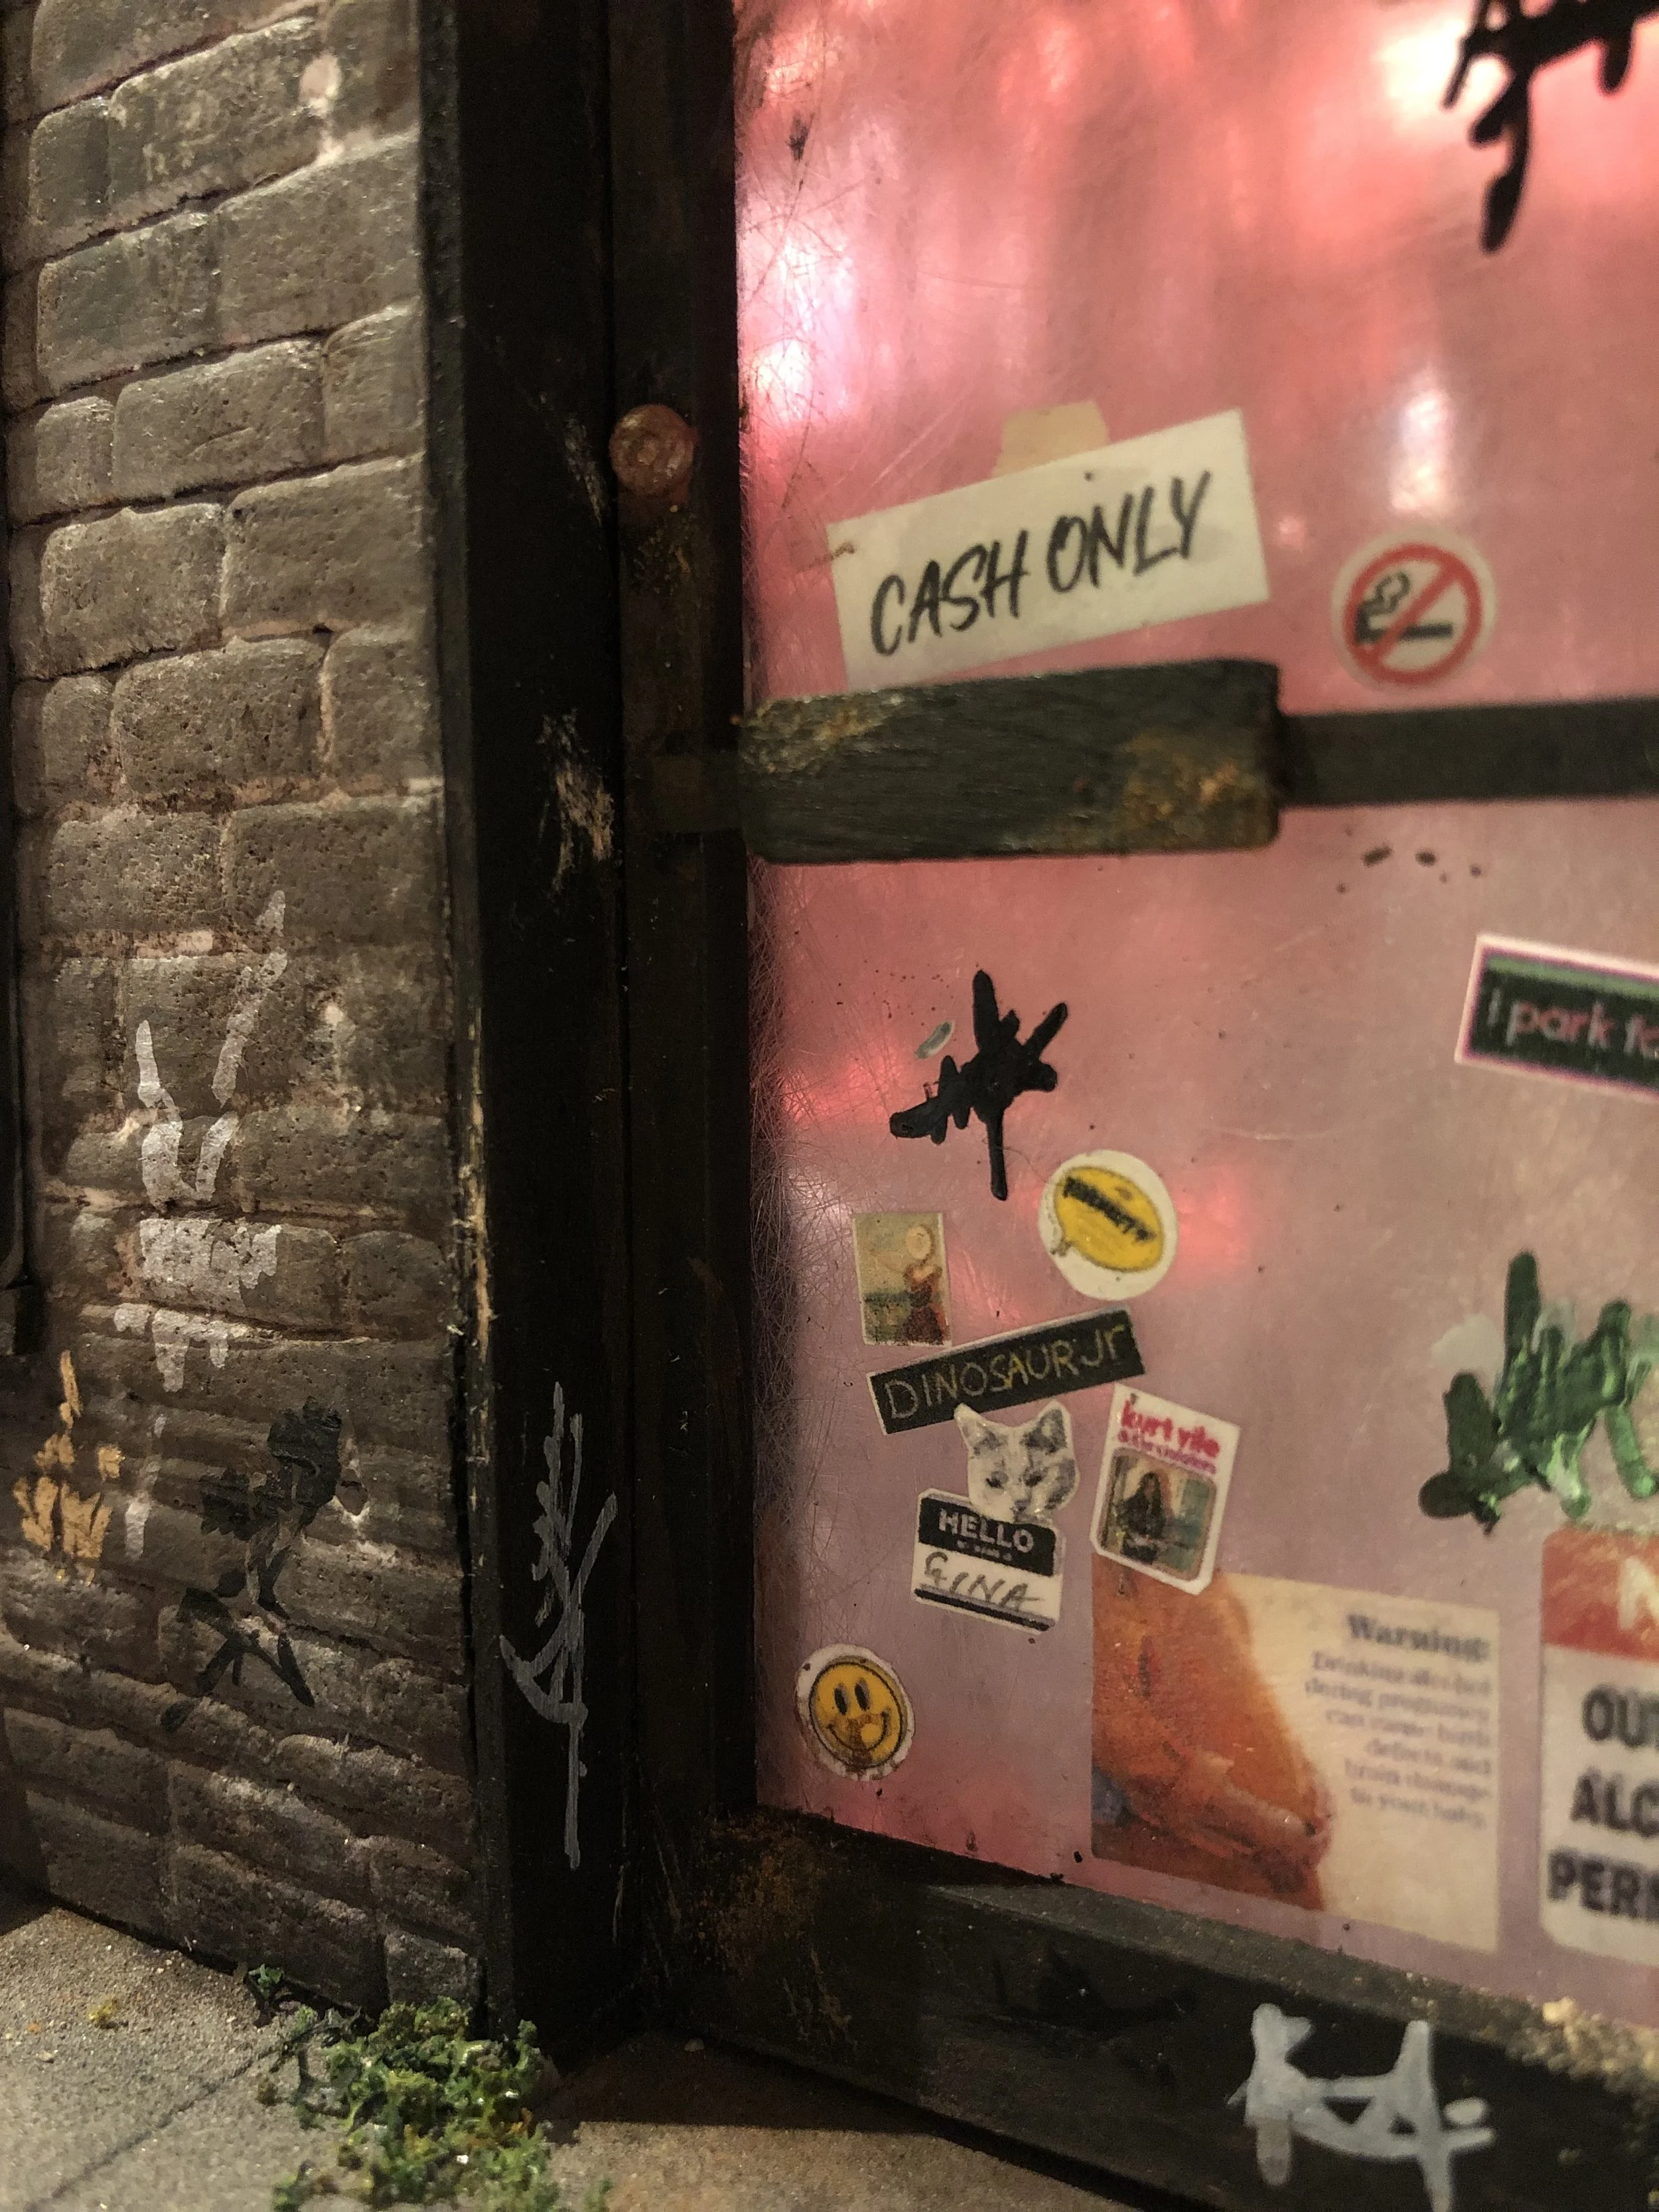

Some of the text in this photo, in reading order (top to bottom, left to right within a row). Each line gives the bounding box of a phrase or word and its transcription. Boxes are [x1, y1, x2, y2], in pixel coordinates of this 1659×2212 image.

[871, 471, 1212, 656] CASH ONLY
[1506, 999, 1613, 1049] park
[885, 1340, 1080, 1419] DINOSAUR
[938, 1508, 1034, 1554] HELLO
[924, 1551, 1043, 1613] GINA
